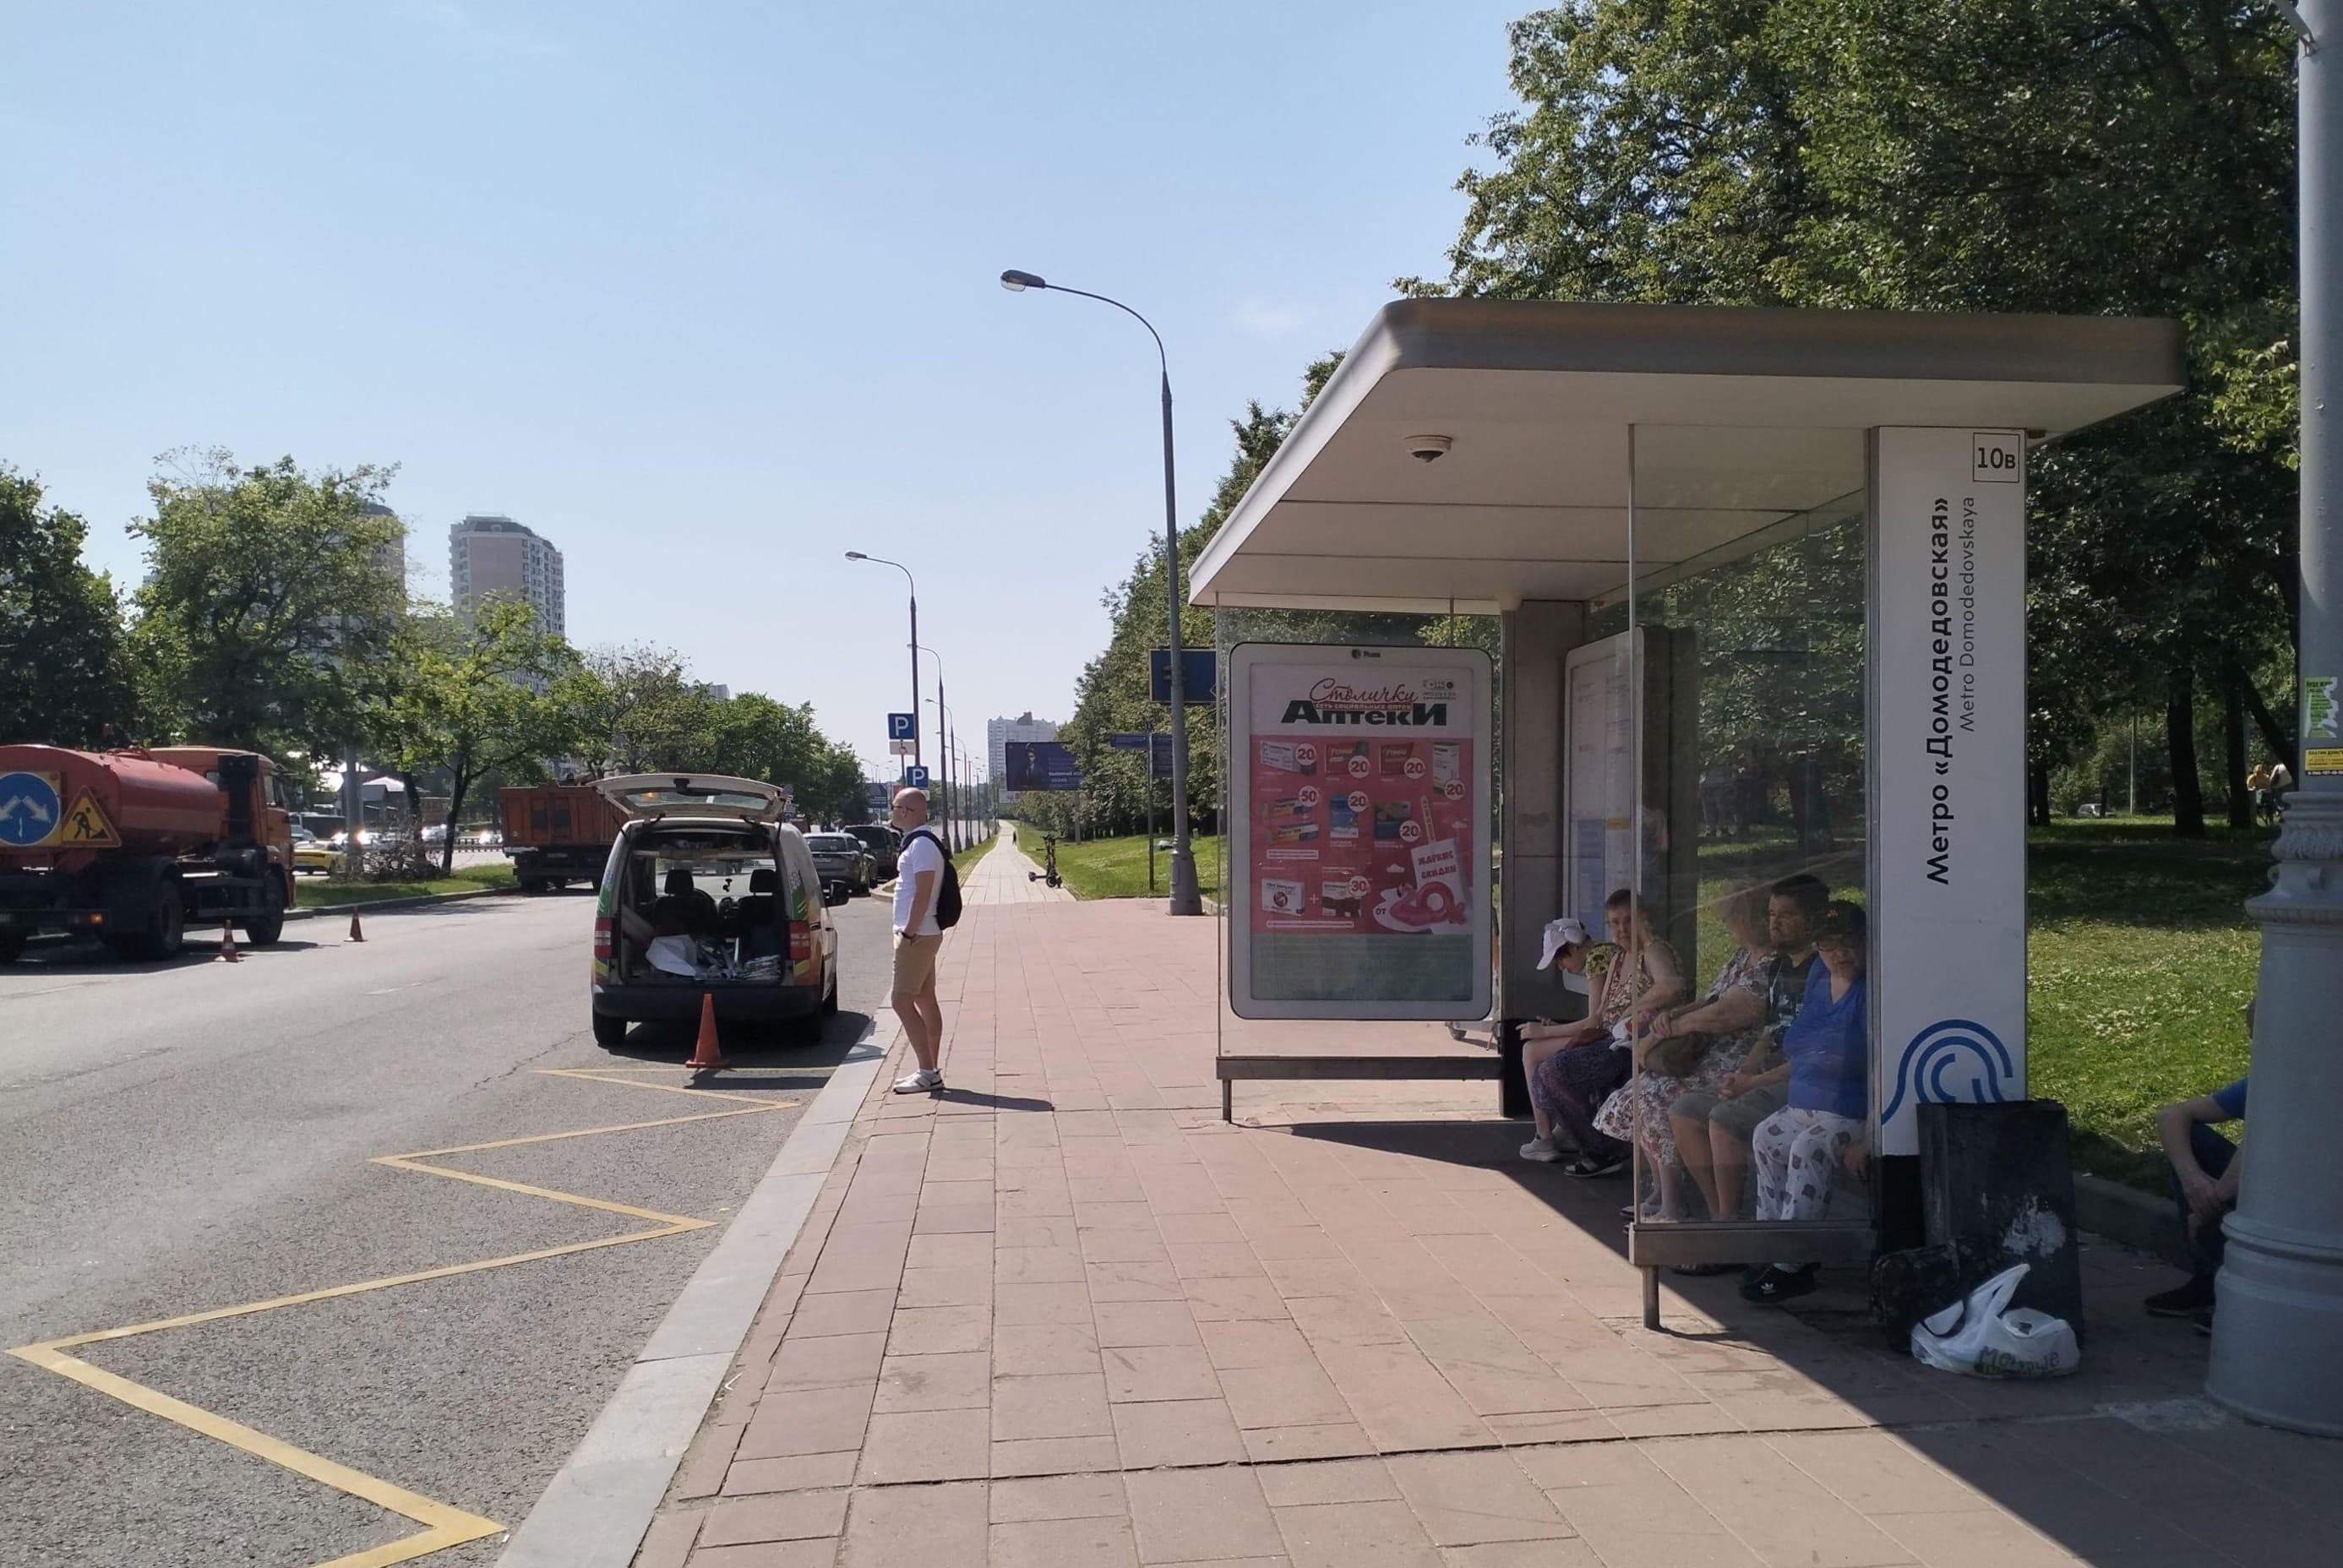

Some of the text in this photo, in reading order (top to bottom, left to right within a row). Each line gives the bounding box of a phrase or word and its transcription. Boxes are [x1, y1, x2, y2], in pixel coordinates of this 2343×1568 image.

[1959, 497, 1978, 732] Metro Domodedovskaya
[1310, 678, 1418, 702] Столички
[1926, 497, 1954, 885] Метро «Домодедовская»
[895, 716, 909, 737] P
[912, 769, 925, 786] P
